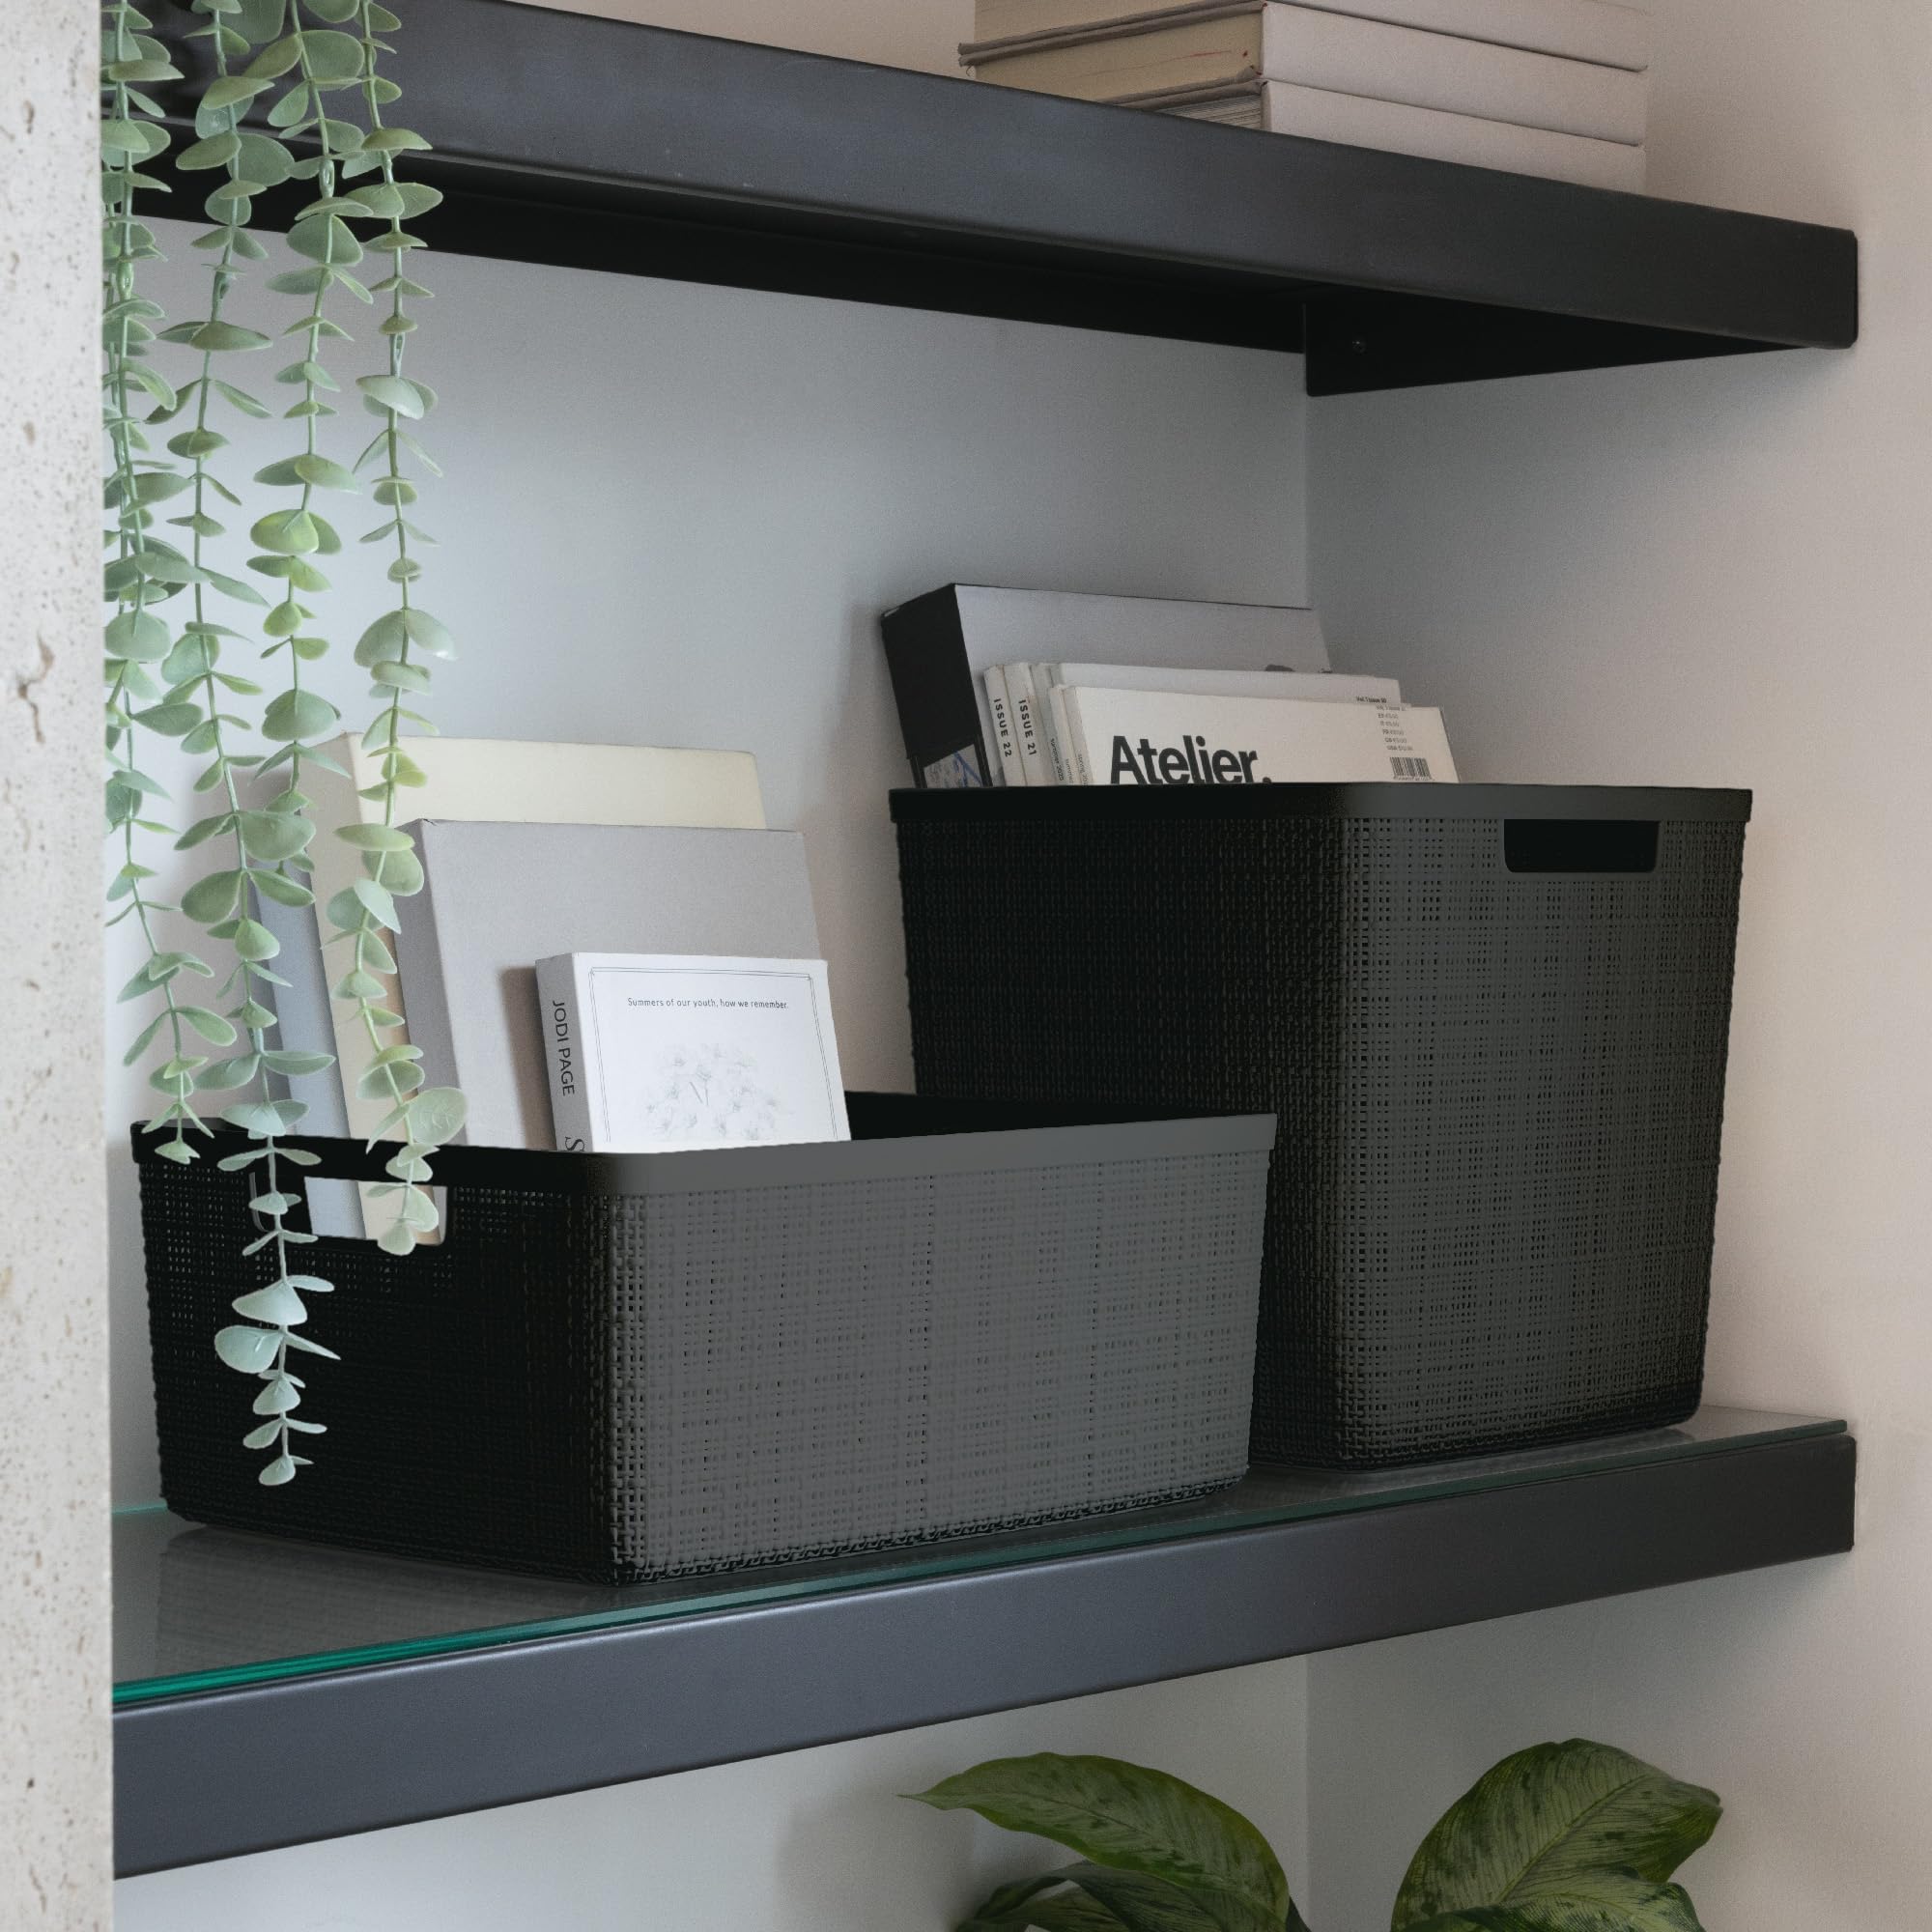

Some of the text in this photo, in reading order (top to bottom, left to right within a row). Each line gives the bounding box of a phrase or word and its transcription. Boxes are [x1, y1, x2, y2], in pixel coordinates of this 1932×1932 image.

[993, 697, 1012, 757] ISSUE 22
[1018, 699, 1037, 755] ISSUE 21
[1110, 734, 1272, 784] Atelier.
[628, 997, 665, 1007] Summers
[667, 998, 675, 1007] of
[694, 999, 719, 1009] youth,
[721, 999, 736, 1008] how
[751, 1000, 789, 1009] remember.
[553, 1000, 575, 1096] JODI PAGE
